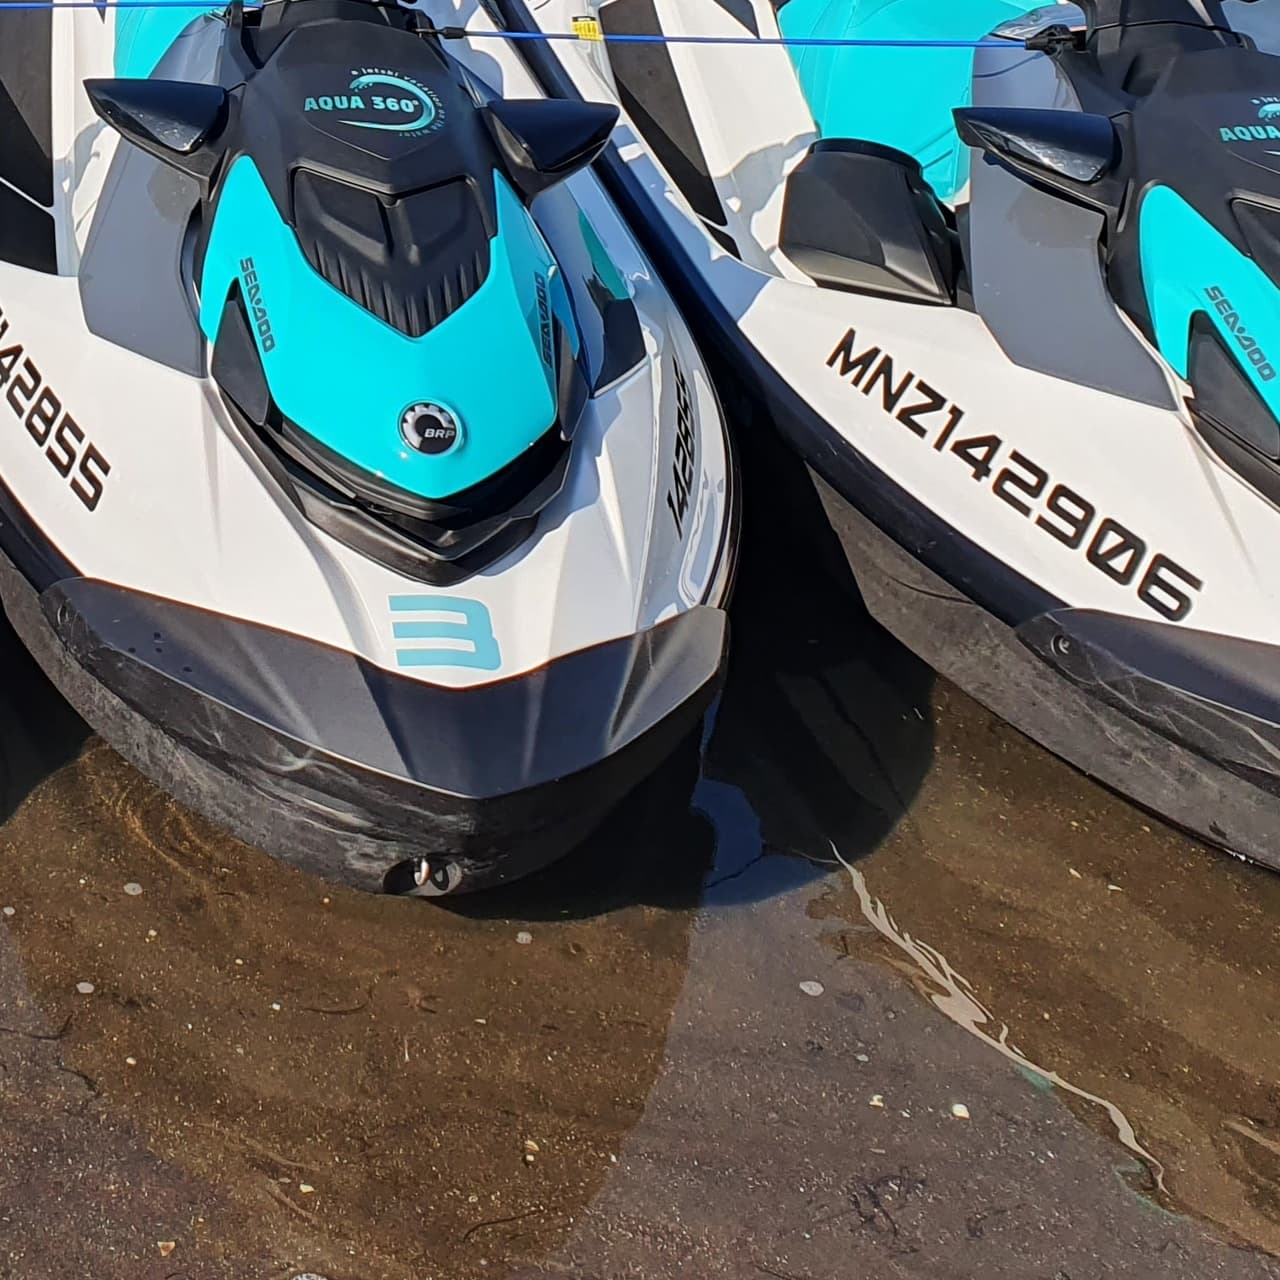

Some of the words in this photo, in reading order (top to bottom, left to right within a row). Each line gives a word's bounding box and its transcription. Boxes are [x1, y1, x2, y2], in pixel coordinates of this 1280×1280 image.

[304, 95, 365, 112] AQUA
[1220, 125, 1280, 141] AQUA
[424, 428, 455, 438] BRP
[826, 328, 1203, 622] MNZ142906
[388, 595, 501, 670] 3
